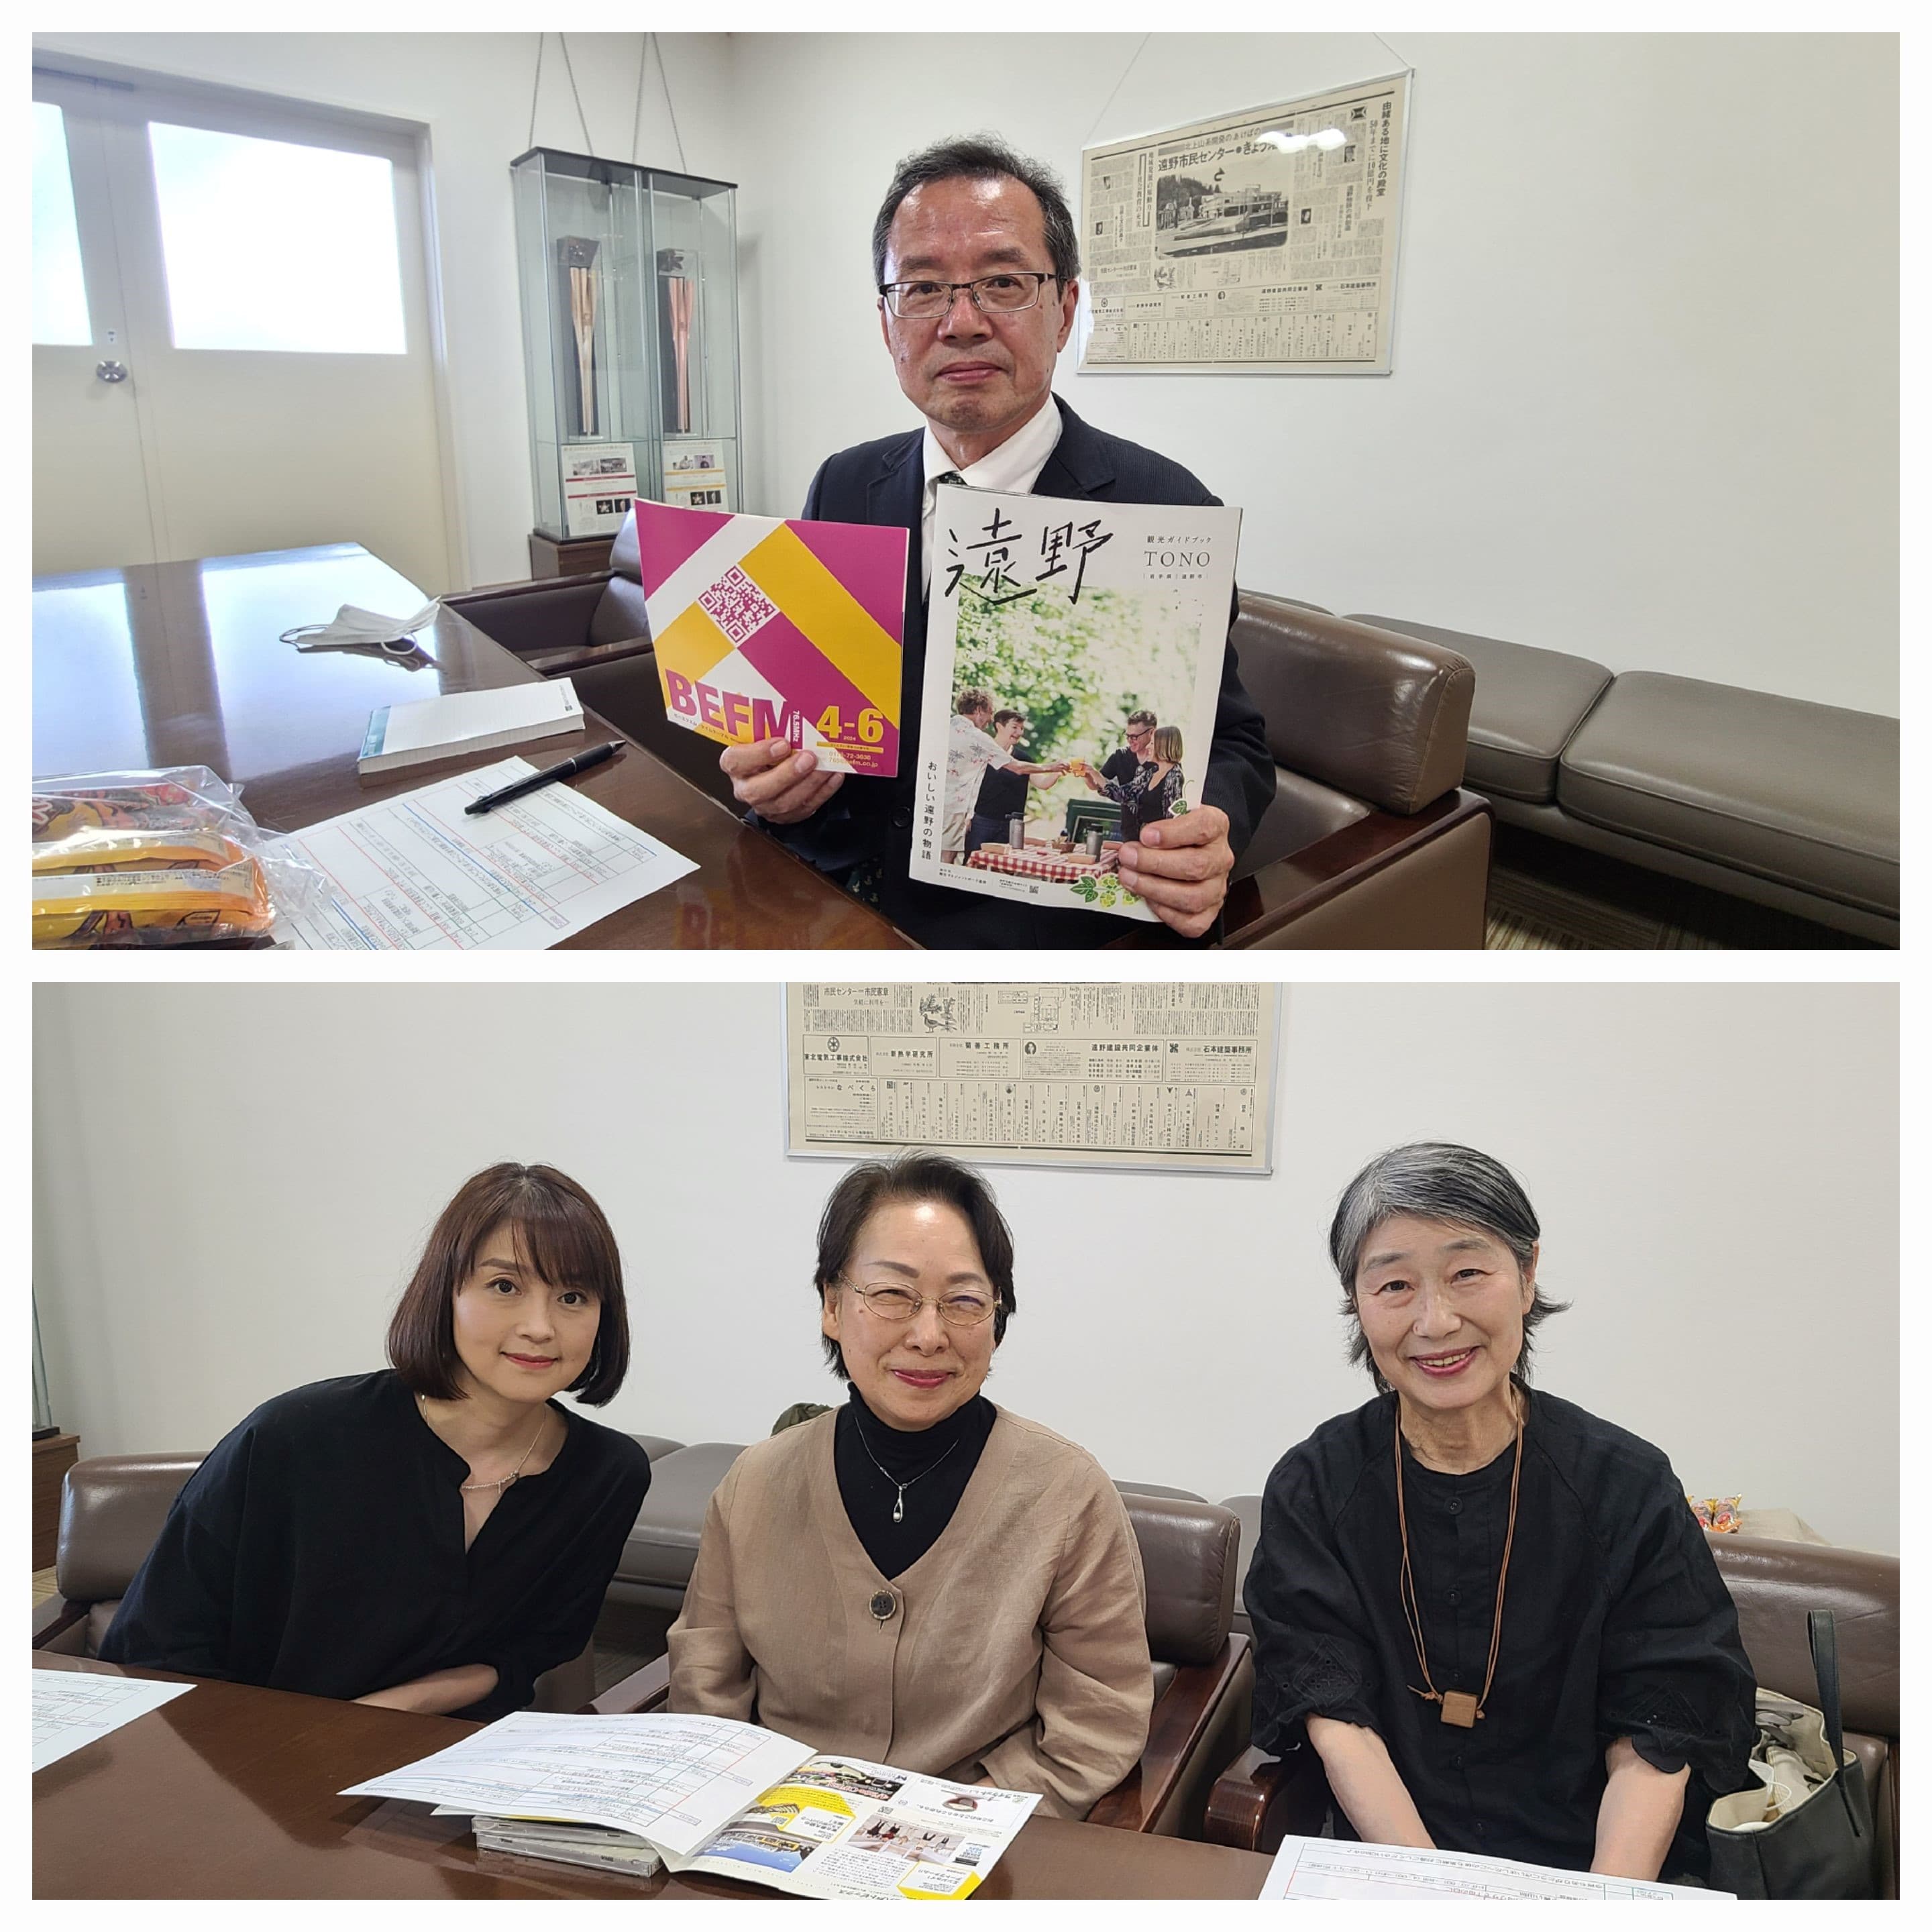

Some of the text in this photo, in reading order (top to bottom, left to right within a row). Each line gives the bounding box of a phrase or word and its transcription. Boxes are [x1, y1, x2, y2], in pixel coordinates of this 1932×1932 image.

[945, 507, 1114, 605] 遠野
[1146, 535, 1212, 544] 観光ガイドブック
[1144, 551, 1210, 568] TONO
[665, 669, 790, 743] BEFM
[816, 705, 884, 743] 4-6
[792, 710, 800, 743] 76.5MHz
[921, 761, 937, 860] おいしい遠野の物語
